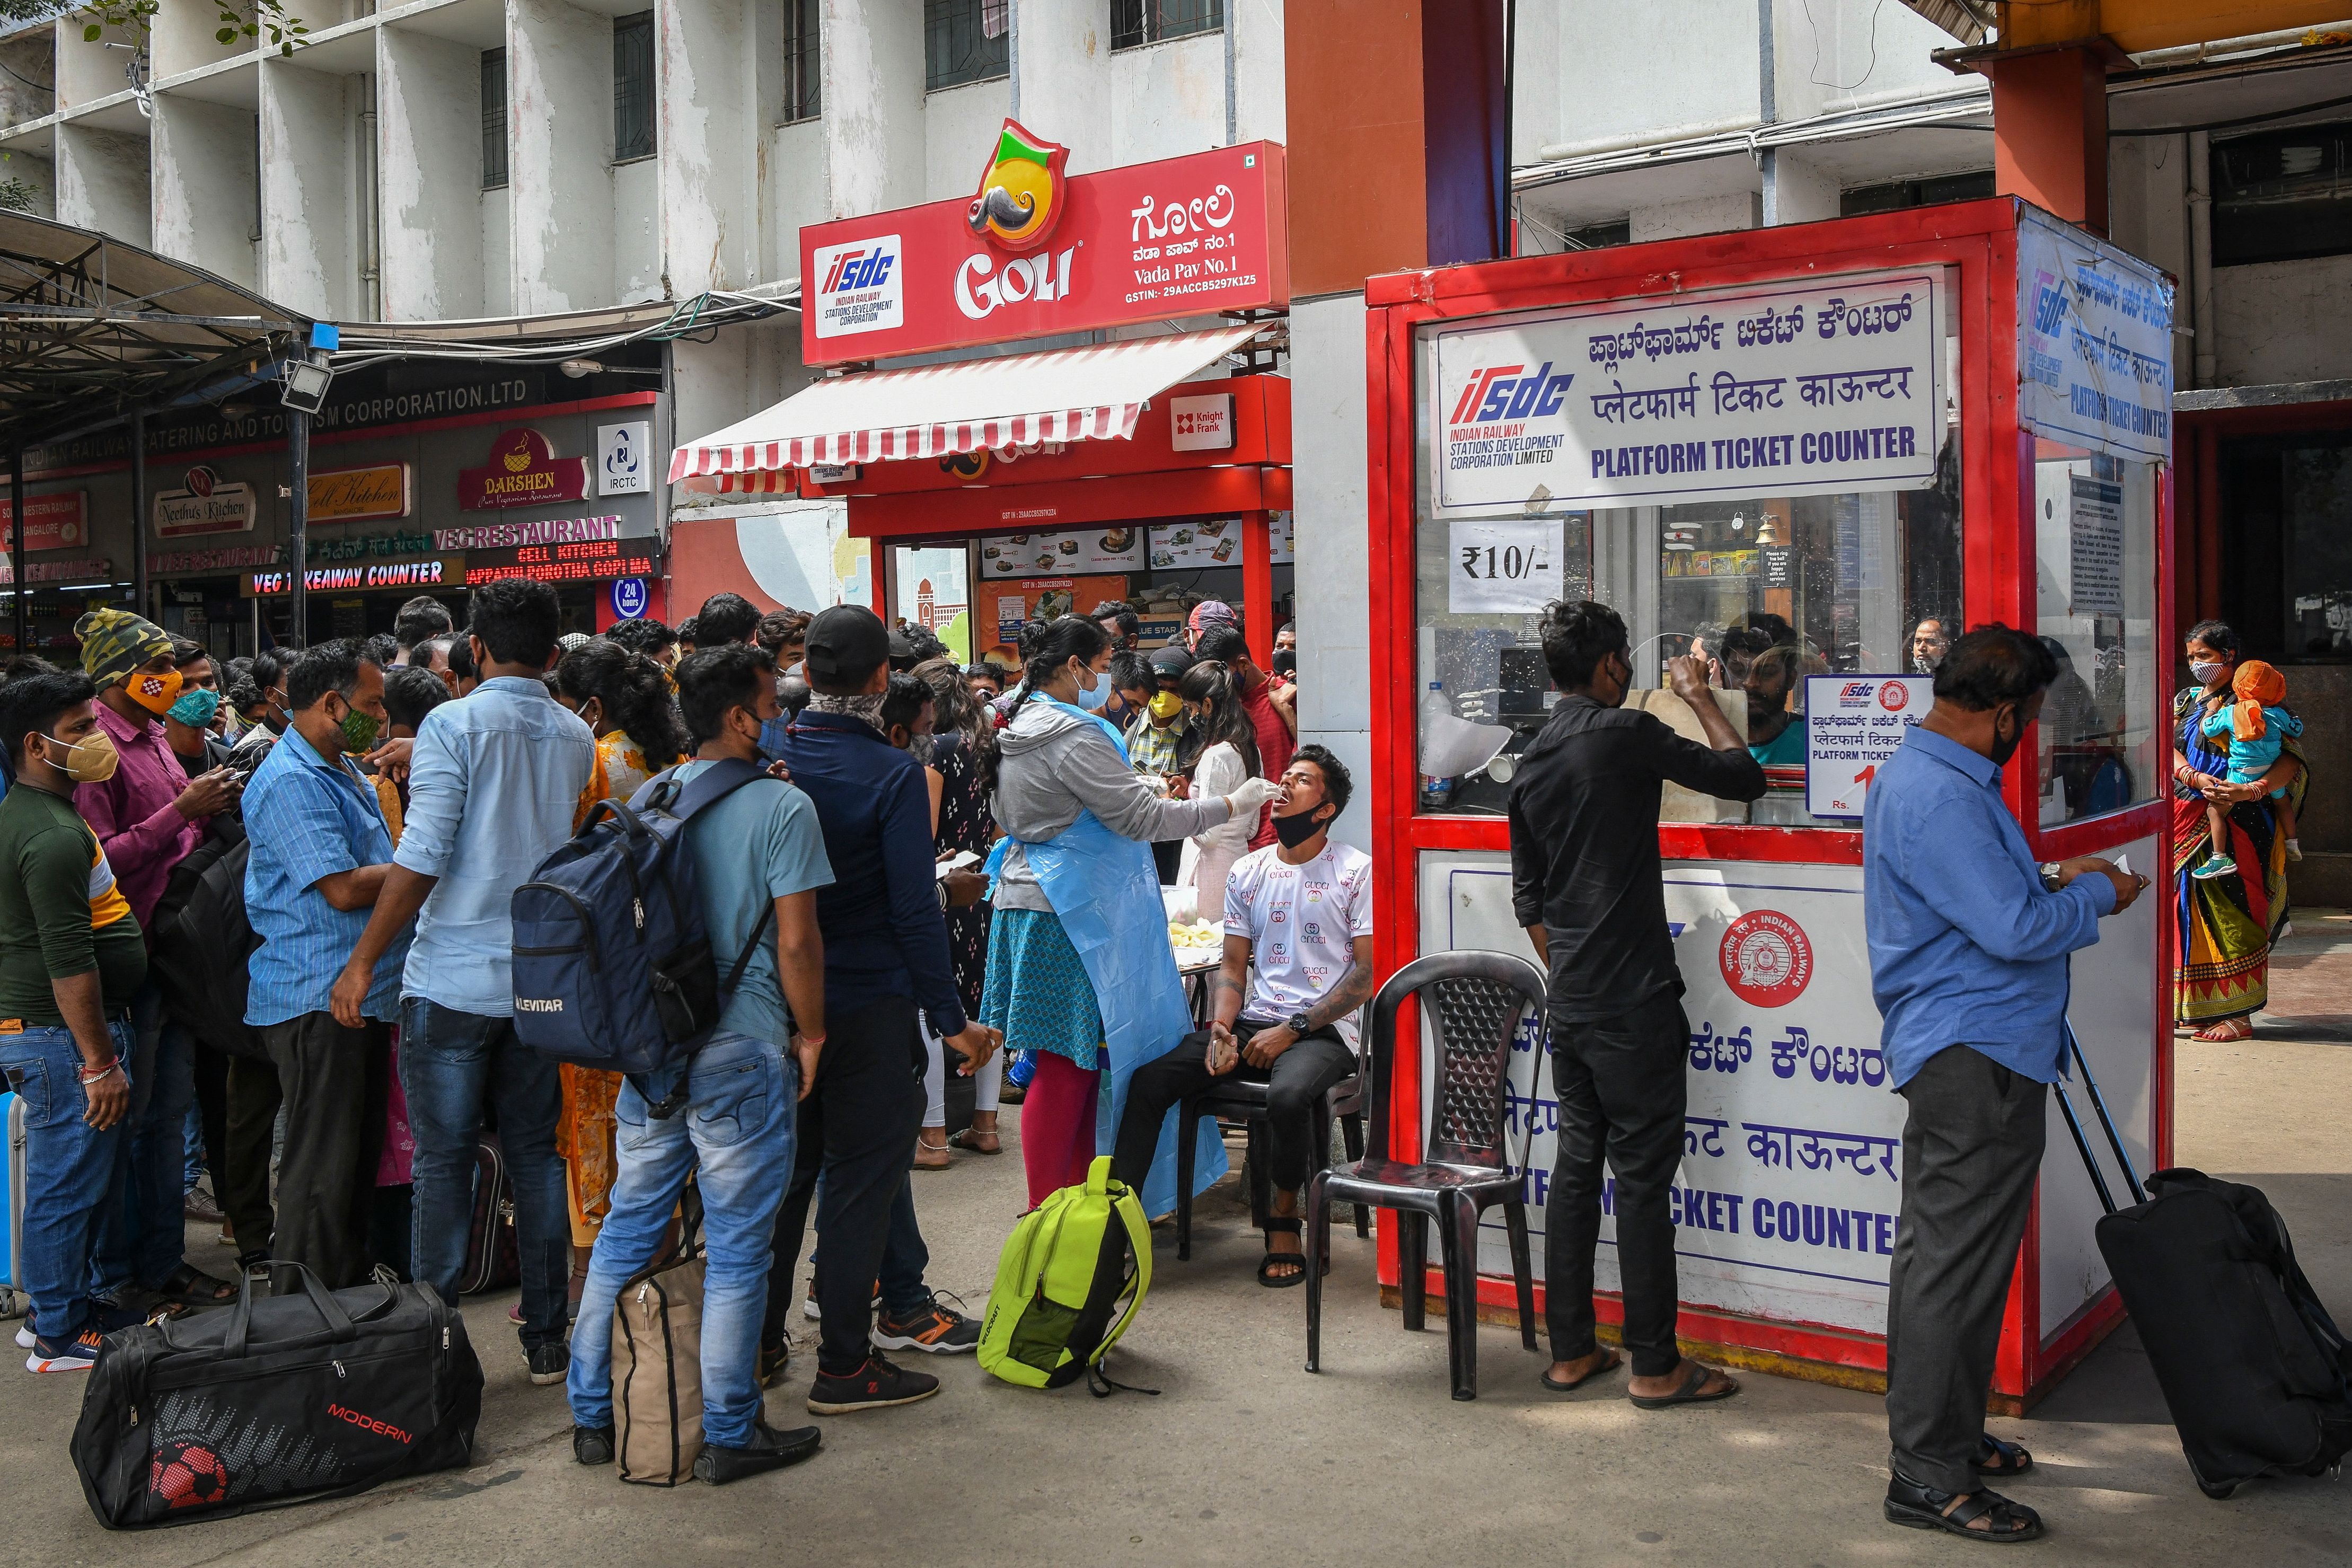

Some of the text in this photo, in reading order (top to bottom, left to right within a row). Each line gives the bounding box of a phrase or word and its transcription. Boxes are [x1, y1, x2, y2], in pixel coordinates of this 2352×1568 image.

[1131, 184, 1235, 242] ಗೋಲಿ
[1132, 246, 1160, 262] ವಡಾ
[1166, 238, 1199, 257] ಪಾವ್
[1134, 266, 1170, 285] Vada
[1175, 263, 1201, 279] Pav
[1204, 258, 1228, 275] No.
[835, 291, 881, 307] INDIAN RAILWAY
[1125, 275, 1256, 303] GSTIN:- 29AACCB5297K1Z5
[825, 300, 893, 319] STATIONS DEVELOPMENT
[840, 312, 878, 325] CORPORATION
[1590, 366, 1914, 424] प्लेटफार्म टिकट काऊन्टर
[1196, 411, 1223, 433] Knight Frank
[2071, 383, 2167, 439] PLATFORM TICKET COUNTER
[22, 446, 67, 468] NDIAN
[222, 418, 258, 441] AND
[261, 406, 338, 434] TOUISM
[1450, 424, 1525, 442] INDIAN RAILWAY
[1450, 434, 1564, 456] STATIONS DEVELOPMENT
[1591, 426, 1915, 478] PLATFORM TICKET COUNTER
[1450, 450, 1553, 470] CORPORATION LIMITED
[335, 473, 399, 506] Kitchen
[485, 472, 554, 495] DAKSHEN
[610, 477, 637, 489] IRCTC
[529, 491, 562, 501] Restaurant
[23, 505, 51, 516] WESTERN
[51, 500, 77, 512] RAILWAY
[159, 499, 244, 525] Neethu's Kitchen
[333, 507, 365, 515] BANGALORE
[433, 515, 618, 550] VEG RESTAURANT
[518, 541, 618, 562] CELL KITCHEN
[254, 560, 443, 593] VEG TKEAWAY COUNTER
[624, 583, 636, 597] 24
[622, 598, 639, 607] hours
[1813, 730, 1902, 746] प्लेटफार्म टिकट
[1813, 751, 1859, 760] PLATFORM
[1833, 800, 1849, 809] Rs.
[1305, 881, 1329, 889] GUCCI
[1724, 921, 1749, 972] भारतीय रेल
[1760, 915, 1808, 988] INDIAN RAILWAYS
[1740, 1122, 1902, 1182] काऊन्टर
[1669, 1186, 1743, 1234] CKET
[1752, 1197, 1900, 1256] COUNTE
[981, 1303, 1000, 1345] WILDCRAFT
[328, 1404, 412, 1444] MODERN
